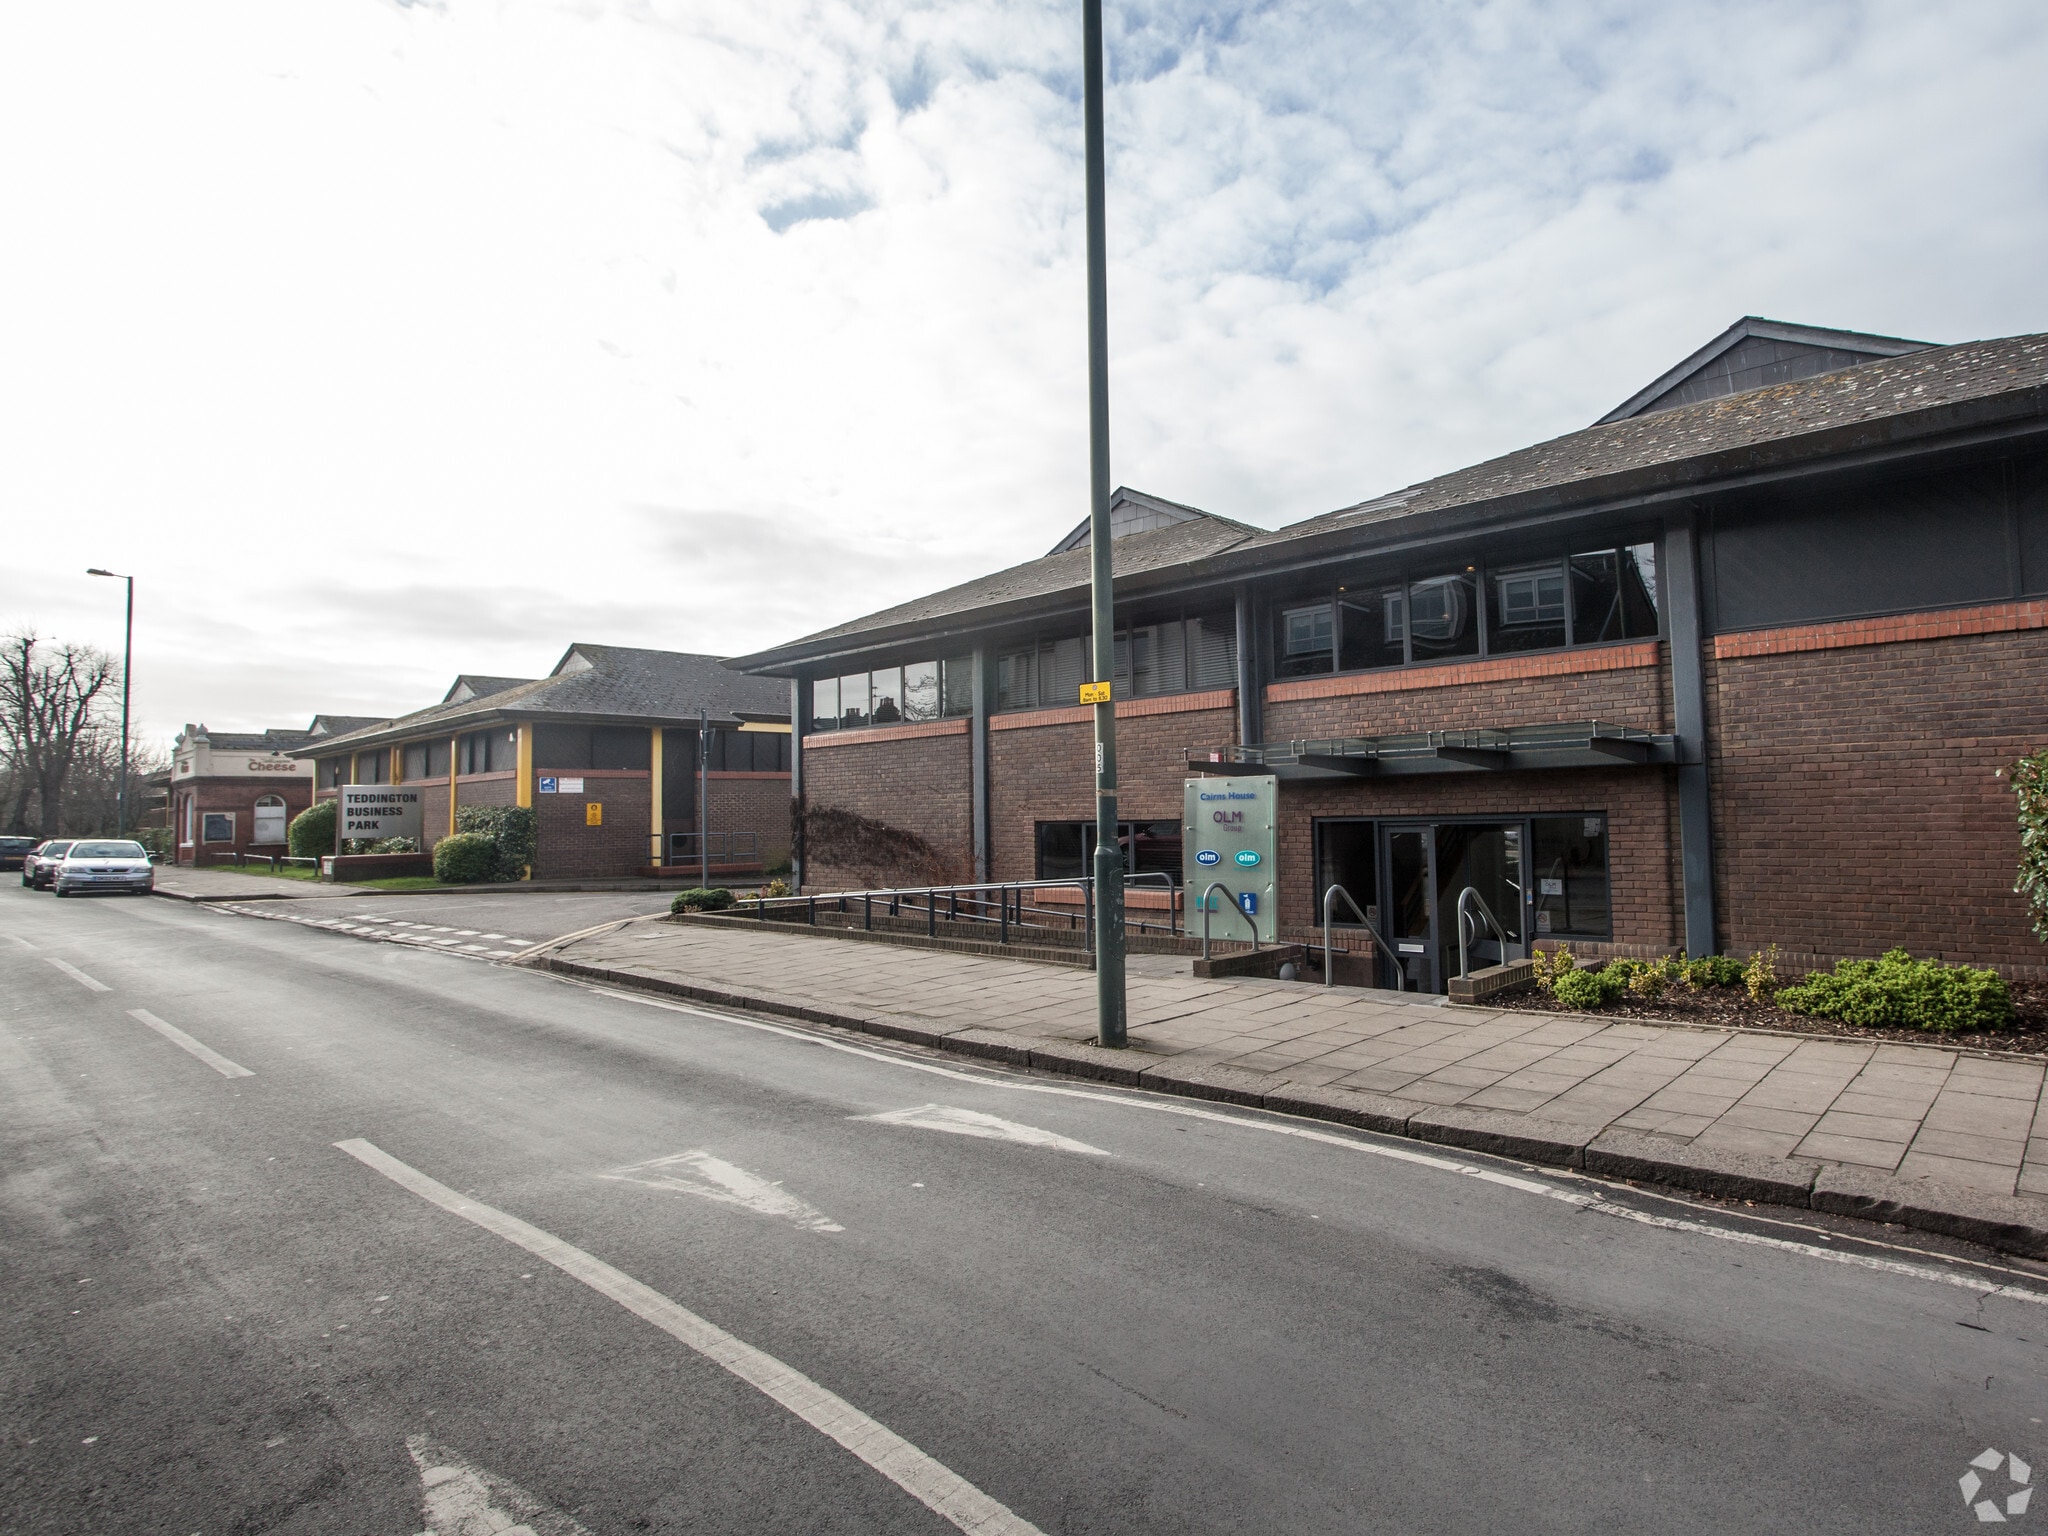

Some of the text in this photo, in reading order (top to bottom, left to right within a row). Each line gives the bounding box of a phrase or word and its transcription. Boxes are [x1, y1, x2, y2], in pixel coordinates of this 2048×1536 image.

[248, 761, 297, 771] Cheese
[347, 794, 418, 804] TEDDINGTON
[1200, 792, 1256, 801] Cairns House
[347, 807, 403, 817] BUSINESS
[1213, 811, 1242, 824] OLM
[347, 820, 380, 830] PARK
[1223, 824, 1242, 832] Group
[1199, 853, 1216, 861] olm
[1238, 853, 1256, 862] olm
